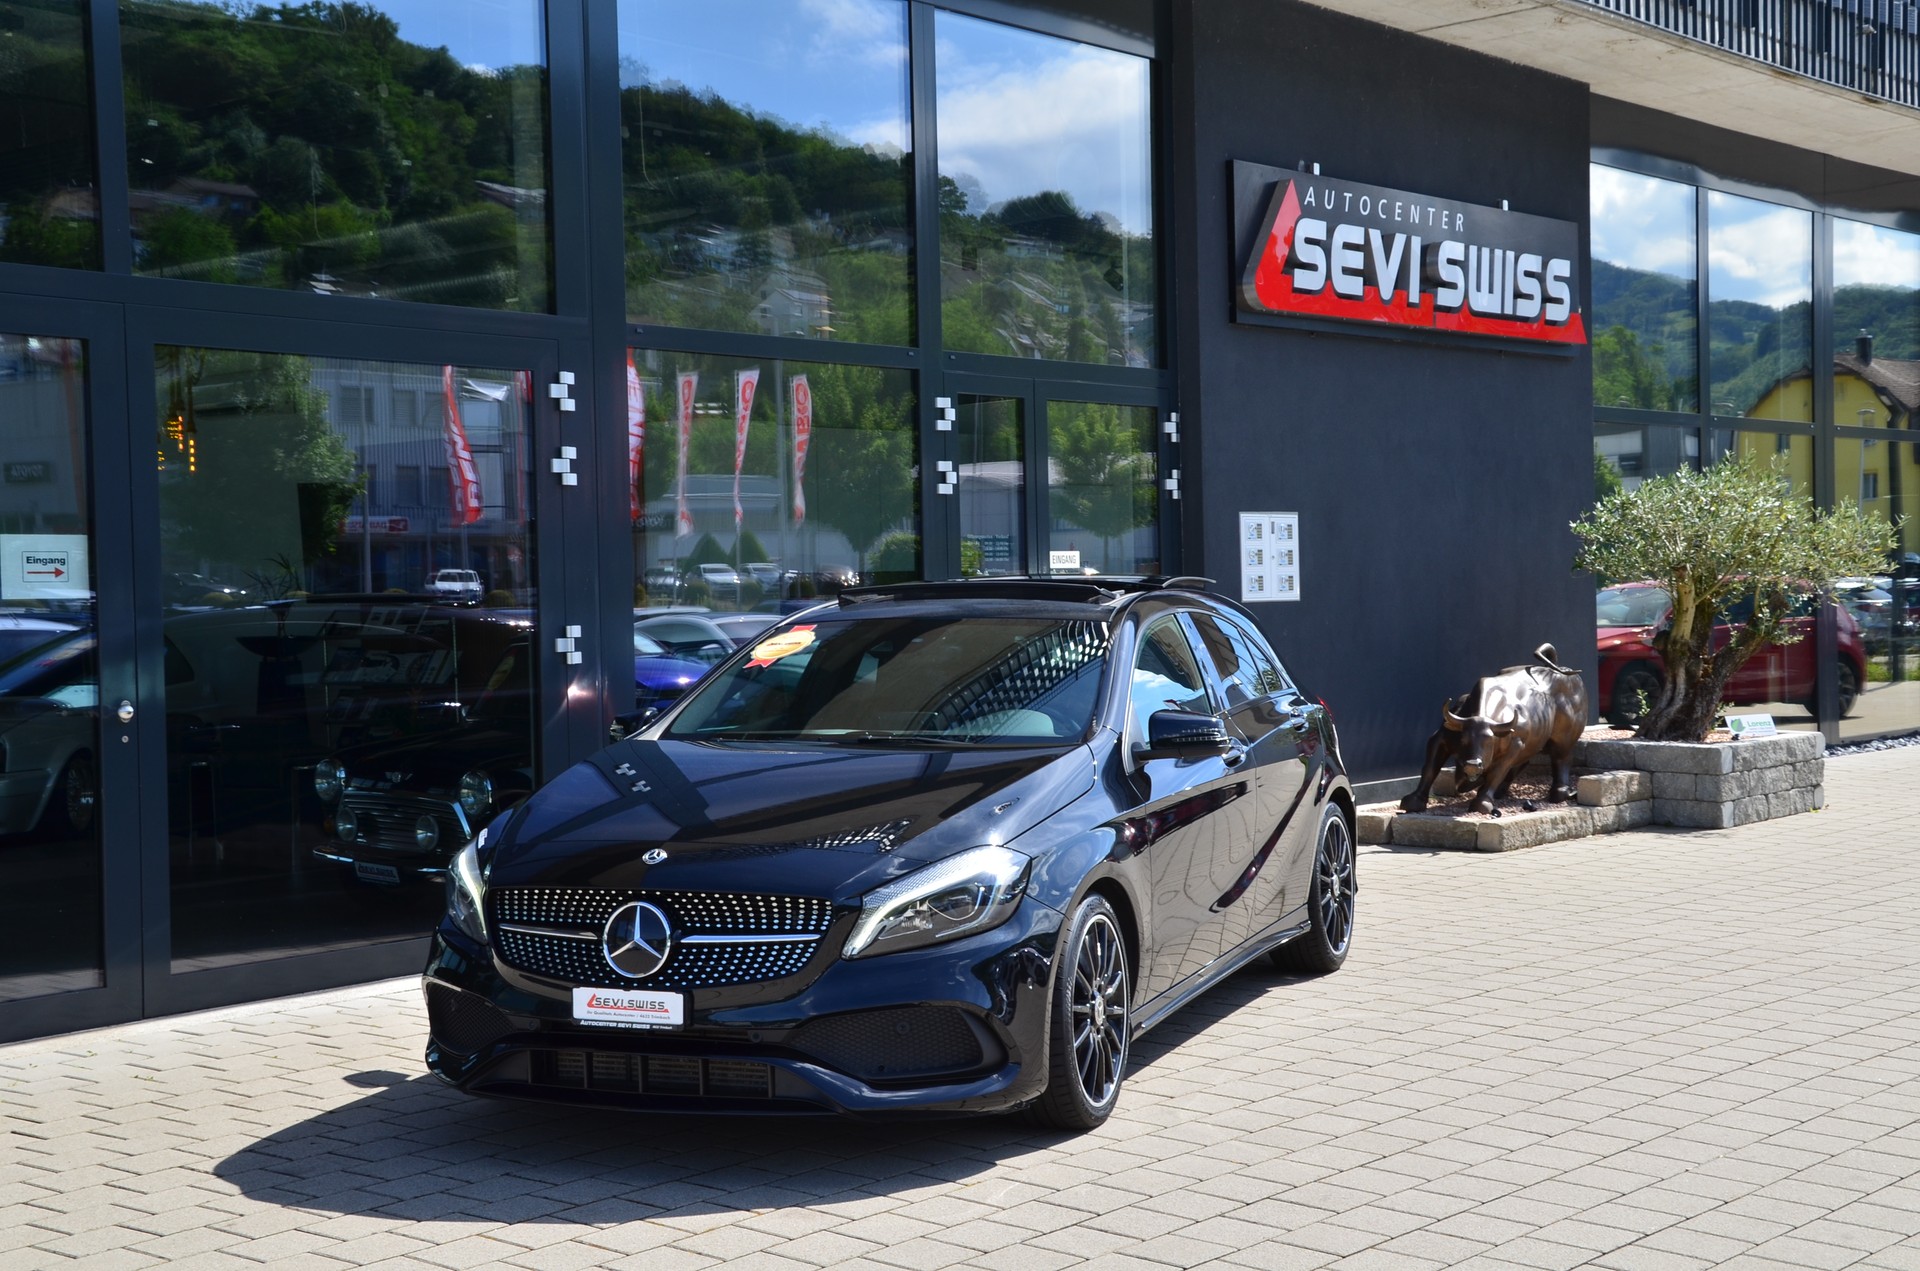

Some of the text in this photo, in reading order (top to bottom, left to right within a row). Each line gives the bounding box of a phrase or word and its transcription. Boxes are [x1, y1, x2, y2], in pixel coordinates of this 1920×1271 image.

[1304, 186, 1465, 233] AUTOCENTER
[1292, 216, 1572, 322] SEVI SWISS
[26, 556, 66, 566] Eingang
[1052, 554, 1077, 565] EINGANG
[594, 997, 665, 1009] SEVI SWISS
